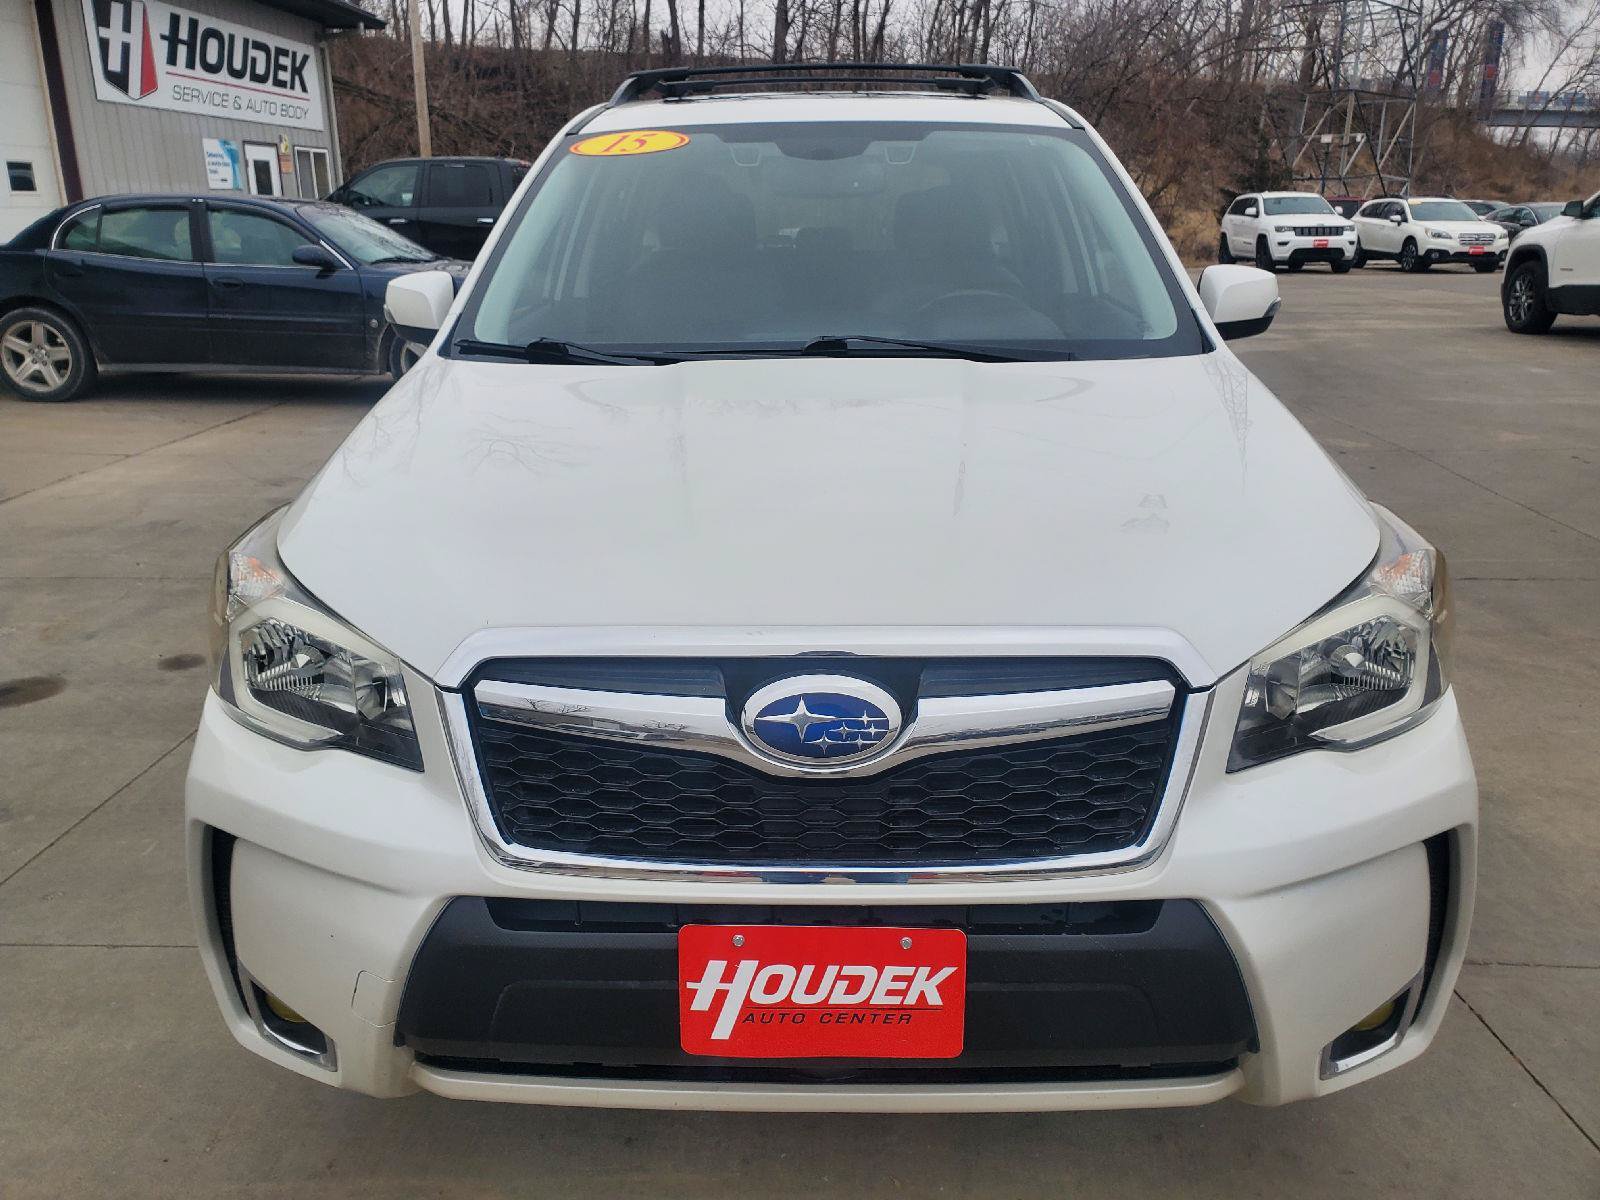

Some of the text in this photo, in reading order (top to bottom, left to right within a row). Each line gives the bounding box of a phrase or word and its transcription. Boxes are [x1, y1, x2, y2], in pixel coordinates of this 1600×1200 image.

[160, 12, 310, 93] HOUDEK
[172, 84, 309, 119] SERVICE & AUTO BODY
[601, 133, 659, 153] 15
[686, 960, 958, 1040] HOUDEK
[742, 1012, 912, 1026] AUTO CENTER
